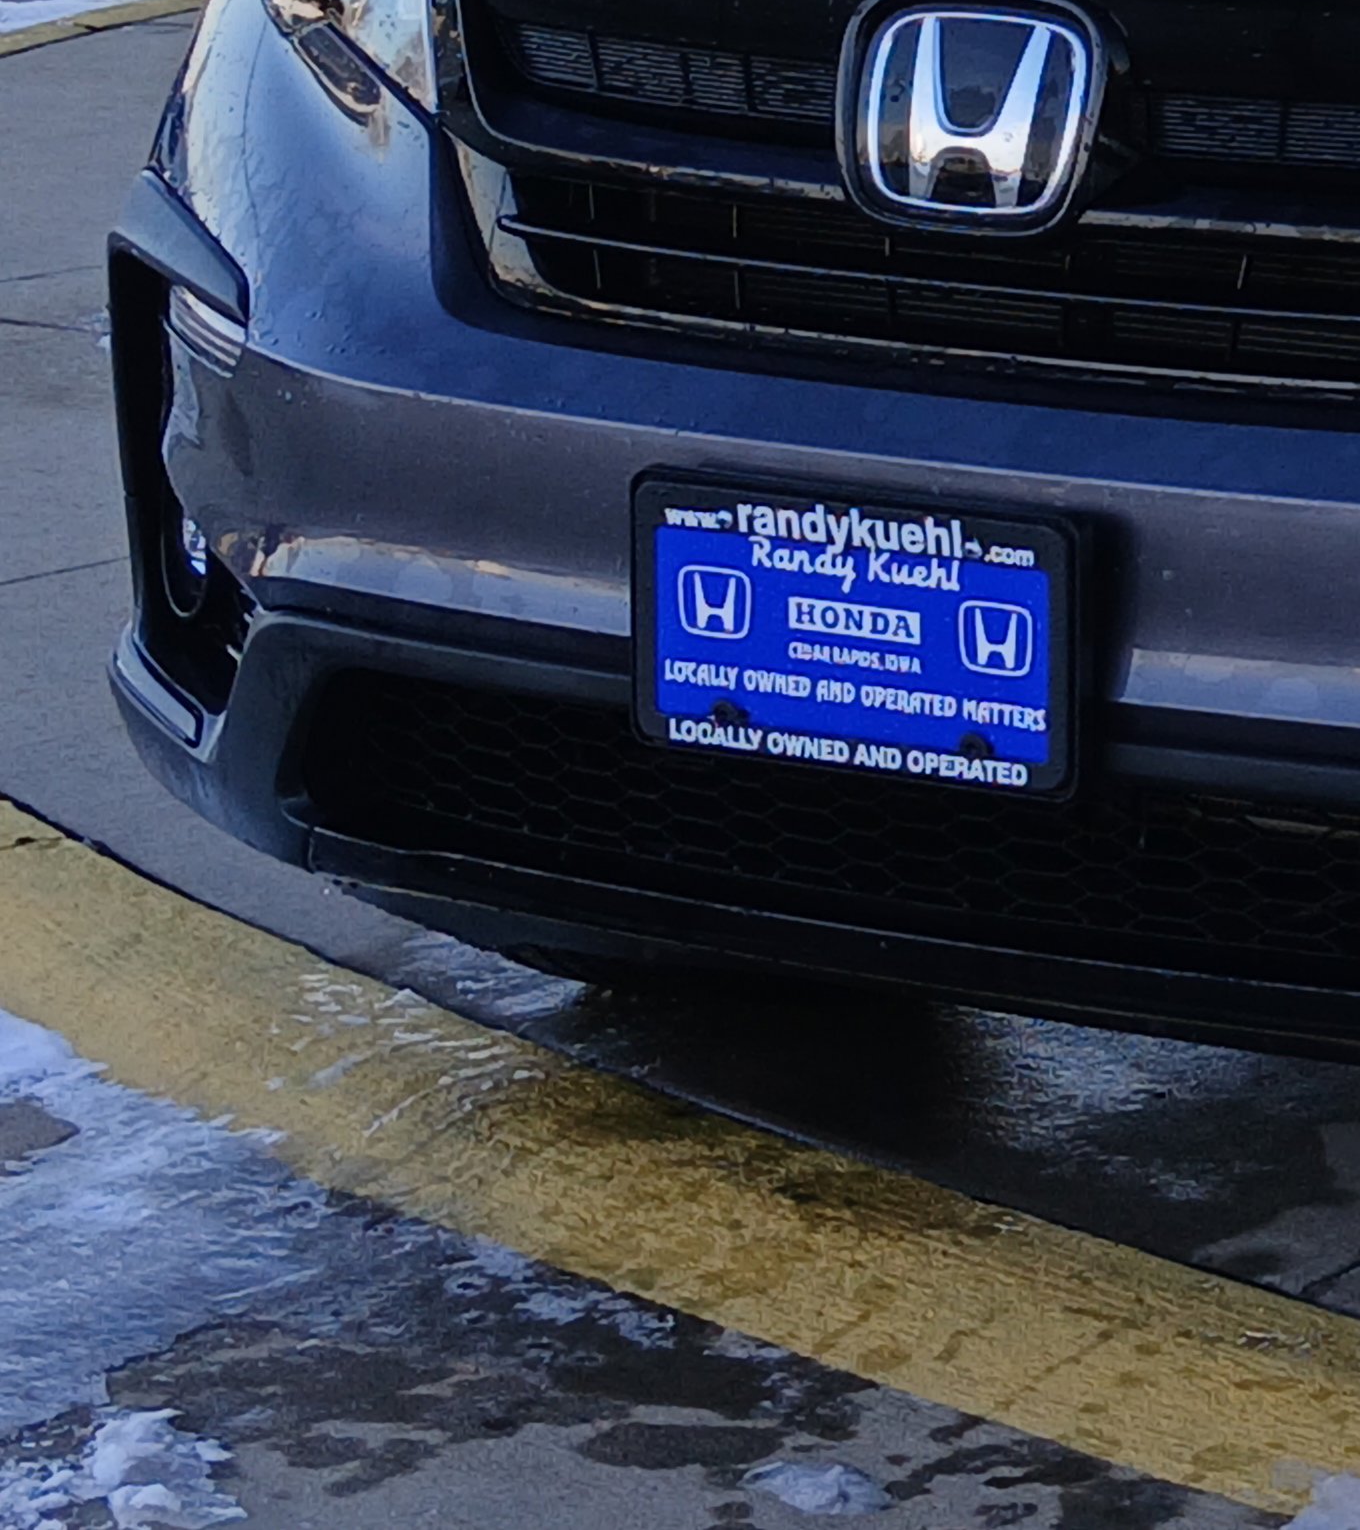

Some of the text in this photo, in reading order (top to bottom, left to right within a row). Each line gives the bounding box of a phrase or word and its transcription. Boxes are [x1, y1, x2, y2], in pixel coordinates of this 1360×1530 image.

[736, 502, 963, 559] randykuehl
[748, 535, 961, 594] Randy Kuehl
[794, 601, 915, 639] HONDA
[663, 657, 1048, 732] LOCALLY OWNED AND OPERATED MATTERS
[668, 717, 1028, 787] LOCALLY OWNED AND OPERATED
